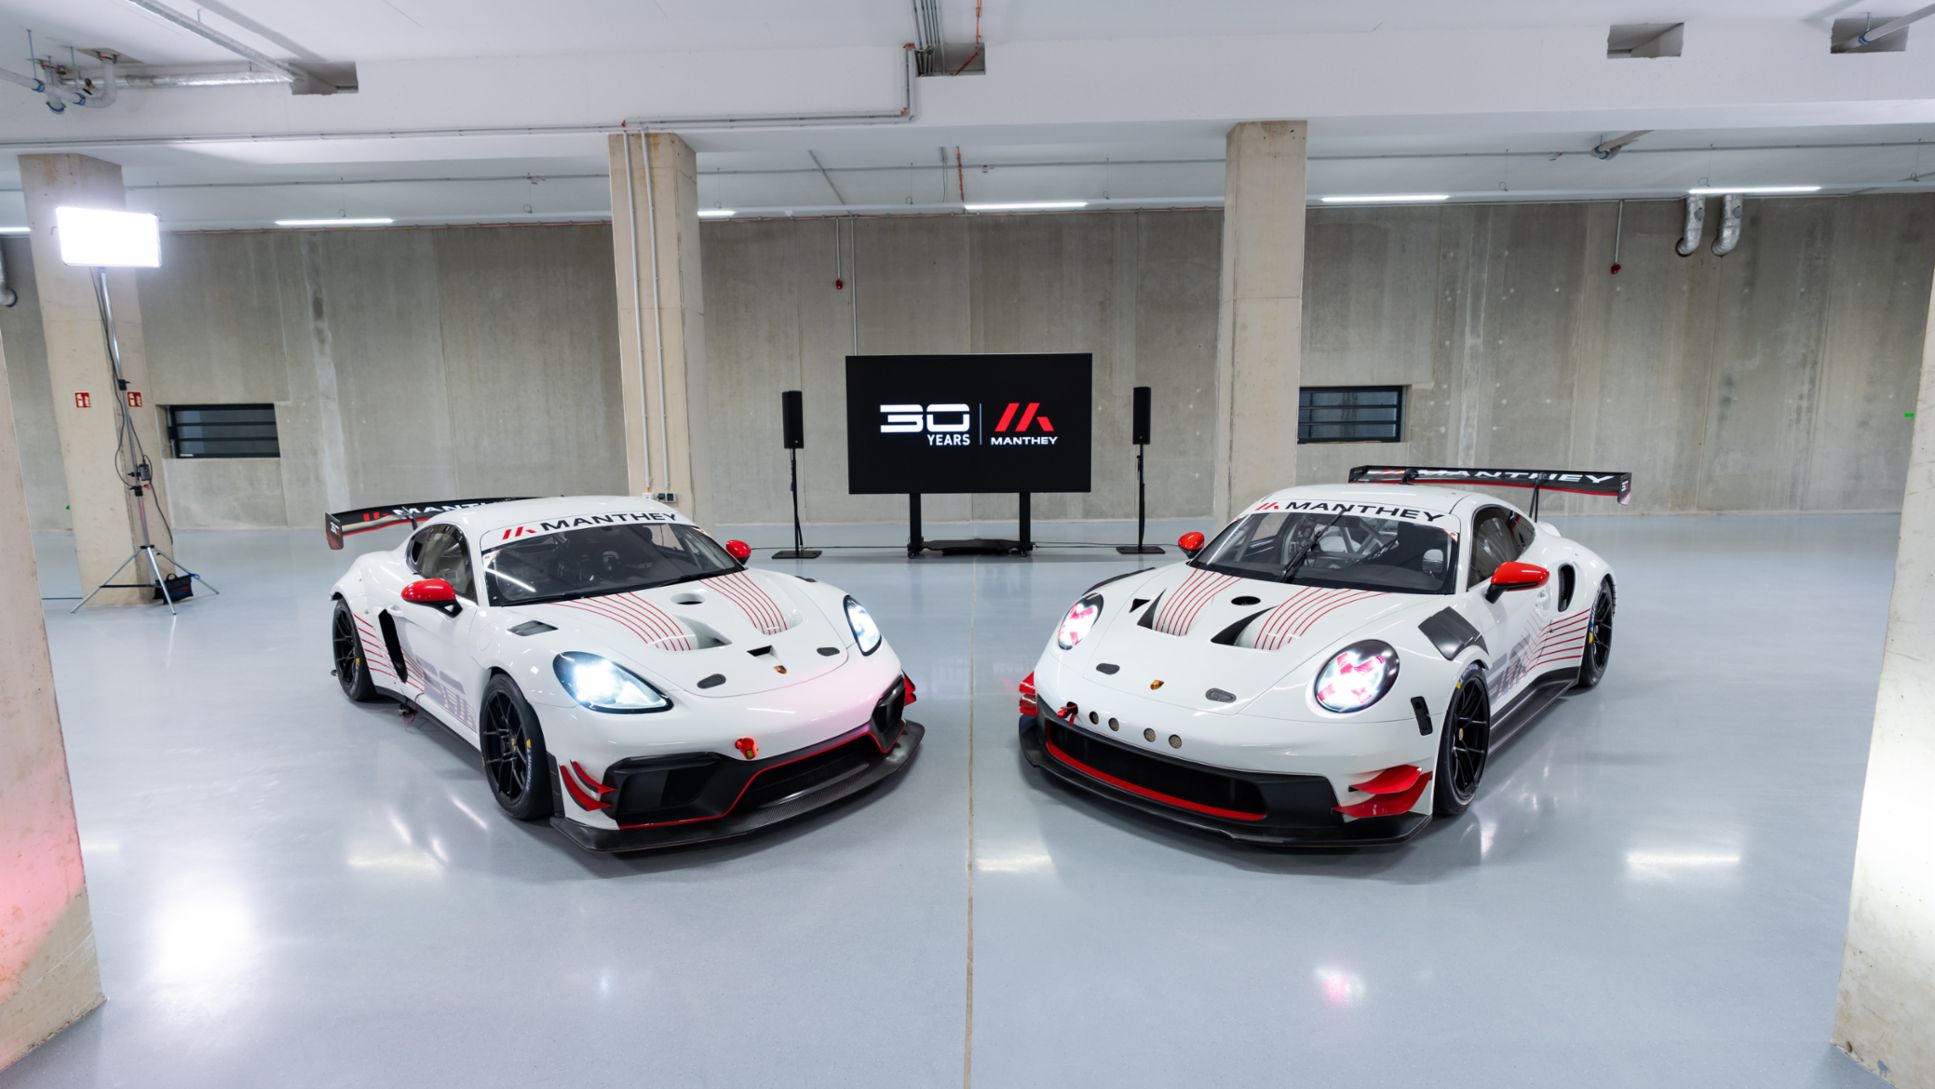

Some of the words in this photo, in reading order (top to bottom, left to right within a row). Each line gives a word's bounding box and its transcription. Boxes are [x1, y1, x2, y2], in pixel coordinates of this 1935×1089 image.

[880, 404, 970, 433] 30
[927, 433, 970, 446] YEARS
[990, 436, 1058, 446] MANTHEY
[392, 503, 487, 516] MANT
[1285, 501, 1445, 522] MANTHEY
[540, 512, 677, 531] MANTHEY
